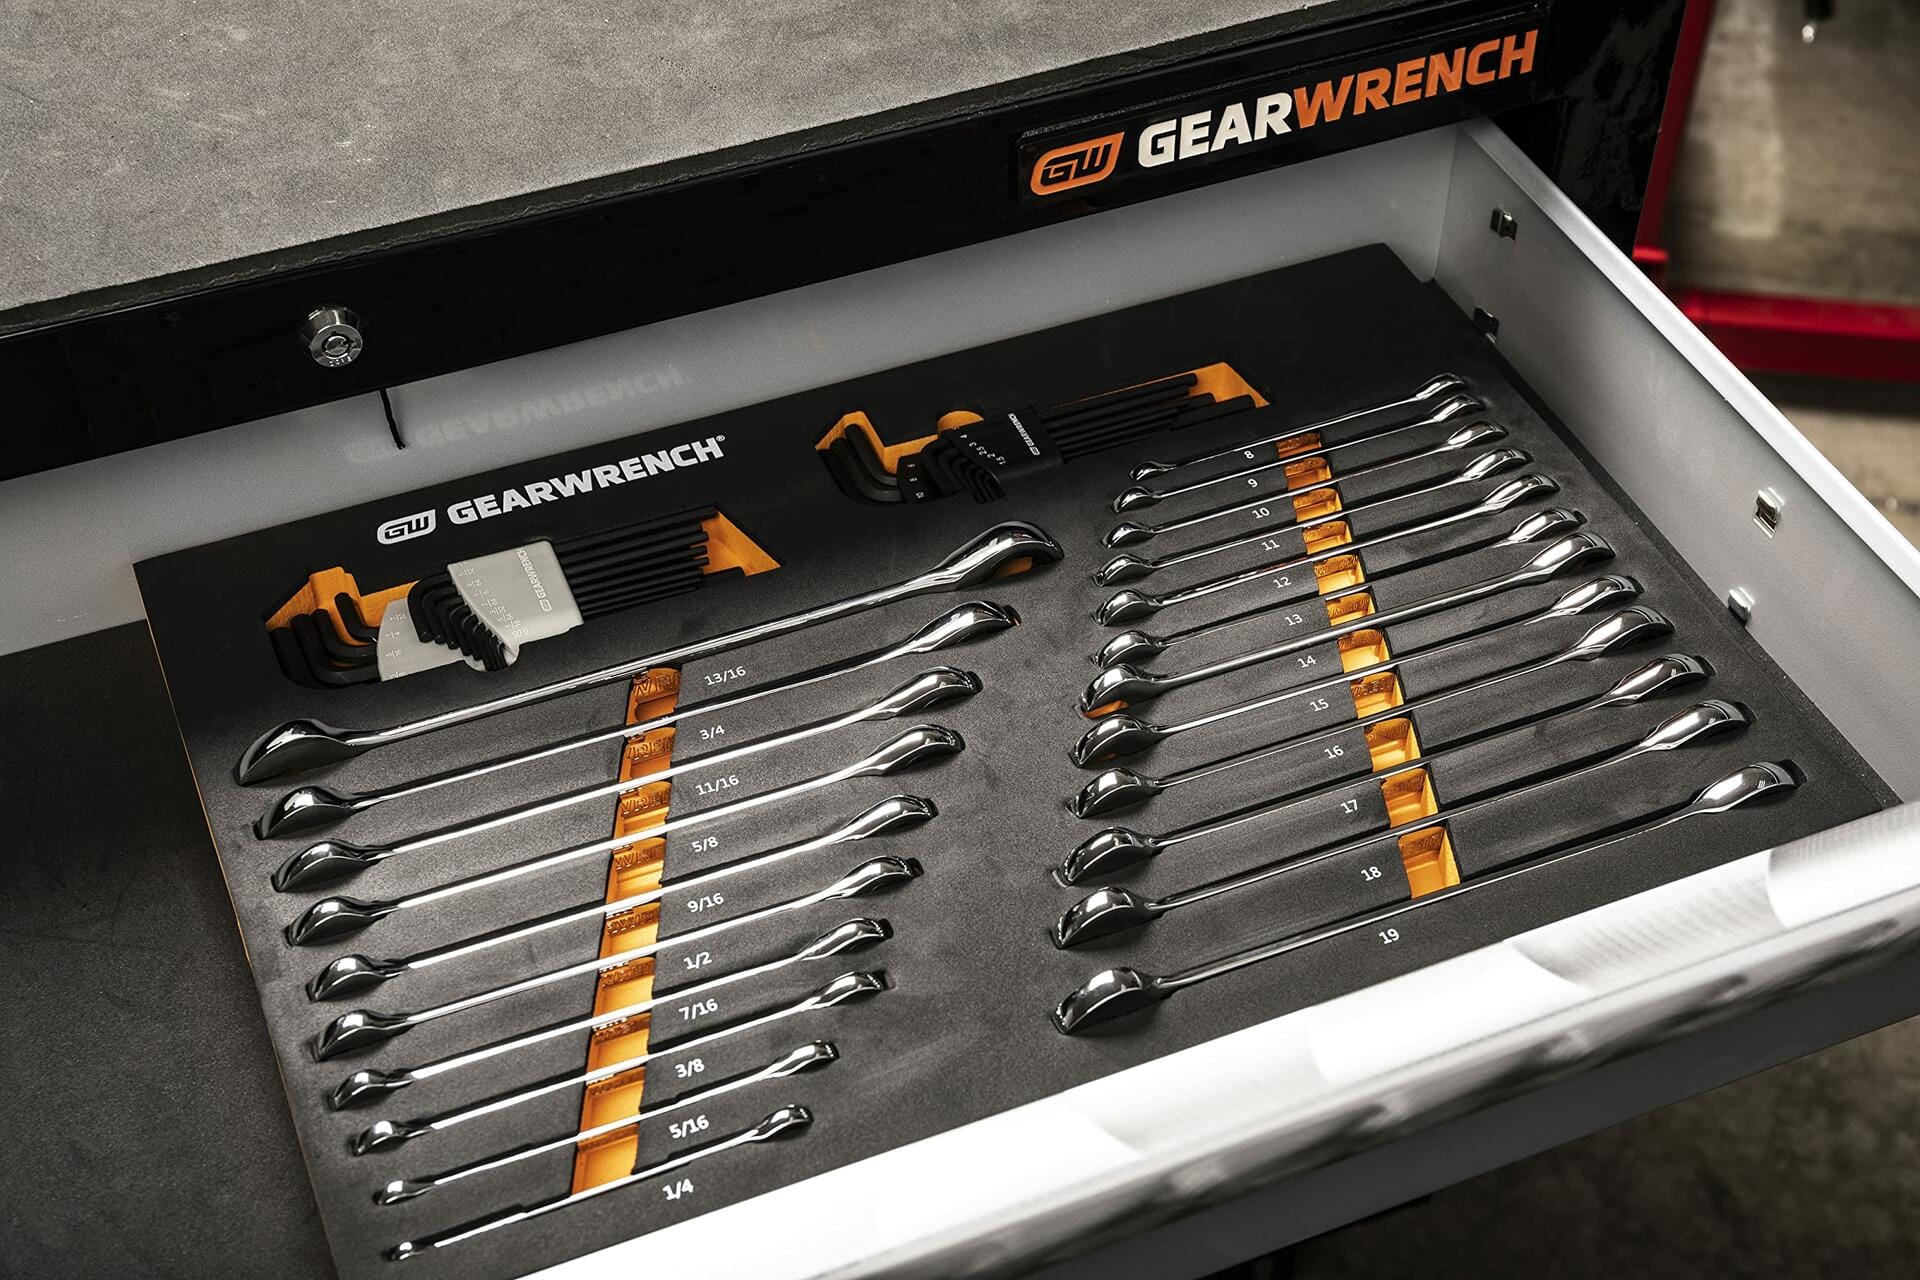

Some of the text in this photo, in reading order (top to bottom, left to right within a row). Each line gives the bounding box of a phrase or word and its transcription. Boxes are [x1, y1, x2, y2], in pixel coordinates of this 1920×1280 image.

[1138, 30, 1538, 168] GEARWRENCH
[1244, 450, 1255, 459] 8
[1247, 478, 1258, 488] 9
[1252, 507, 1271, 519] 10
[1261, 539, 1281, 551] 11
[1273, 576, 1292, 589] 12
[1284, 613, 1303, 626] 13
[1297, 655, 1316, 668] 14
[704, 666, 746, 686] 13/16
[1309, 699, 1329, 712] 15
[699, 725, 725, 740] 3/4
[1324, 745, 1344, 759] 16
[696, 775, 740, 796] 11/16
[1340, 799, 1358, 814] 17
[691, 836, 719, 853] 5/8
[1360, 866, 1382, 882] 18
[687, 893, 724, 913] 9/16
[1378, 928, 1400, 945] 19
[684, 952, 713, 970] 1/2
[679, 998, 719, 1021] 7/16
[675, 1058, 705, 1078] 3/8
[669, 1115, 710, 1139] 5/16
[663, 1179, 694, 1201] 1/4
